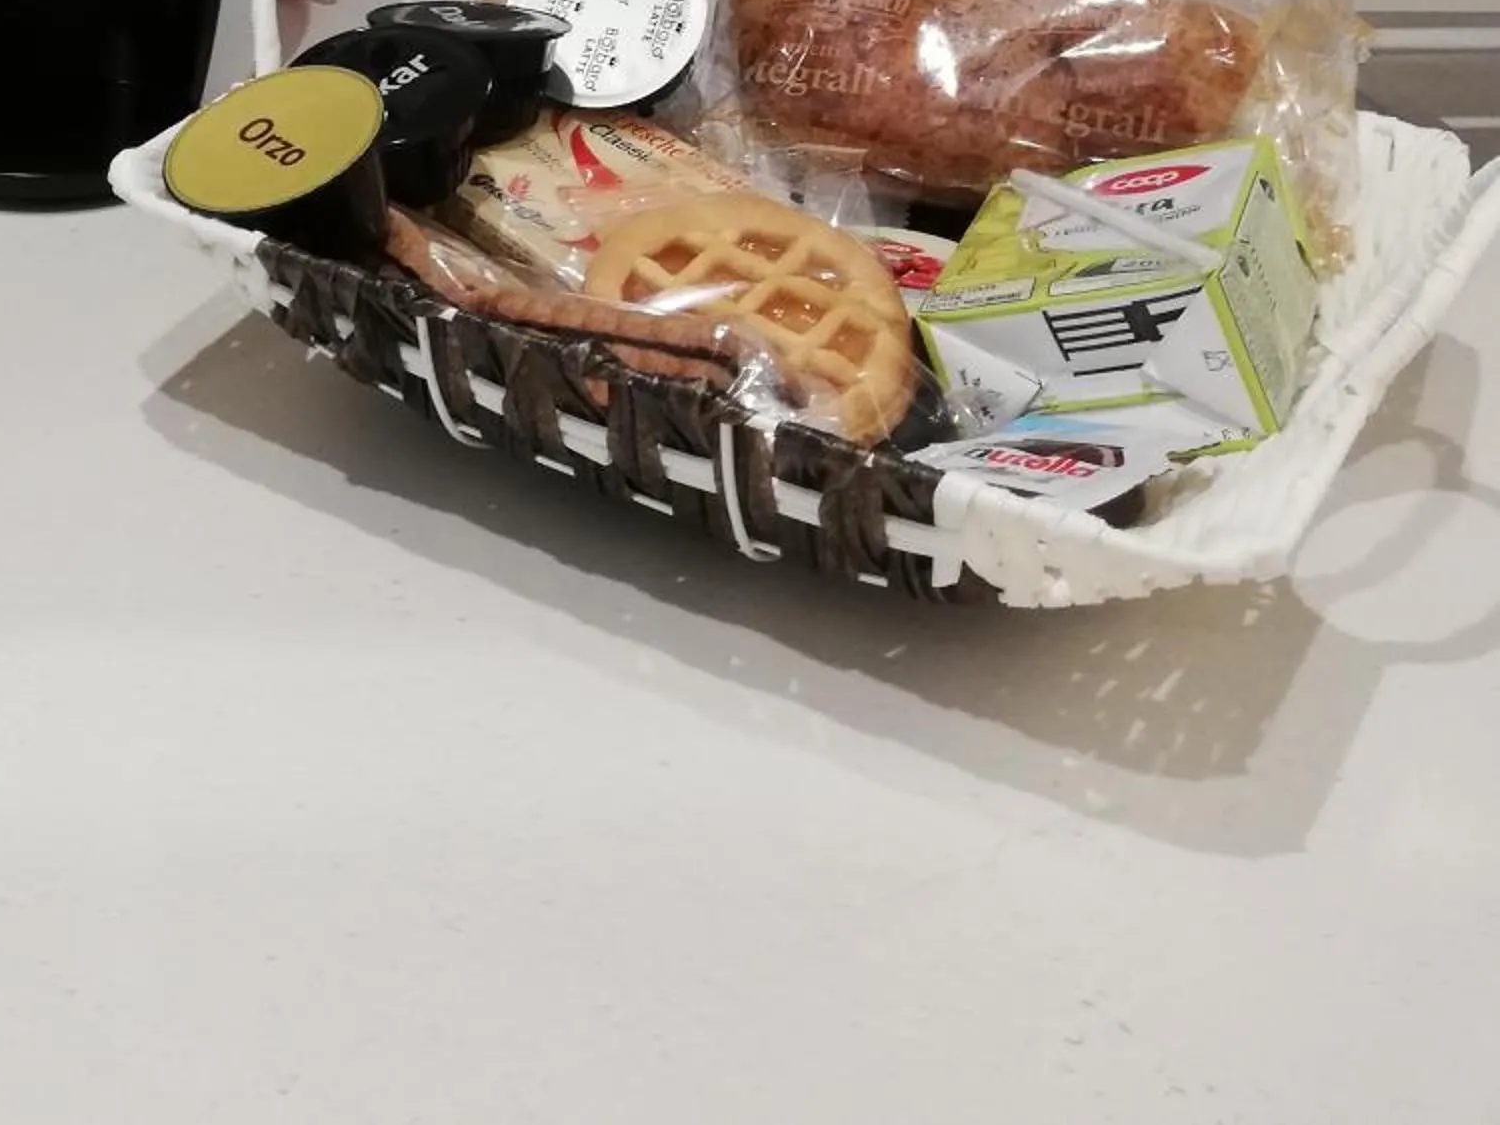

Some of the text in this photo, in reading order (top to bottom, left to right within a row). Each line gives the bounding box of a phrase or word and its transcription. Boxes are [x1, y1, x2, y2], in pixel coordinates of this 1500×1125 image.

[643, 5, 663, 42] LATTE
[379, 54, 430, 96] kar
[576, 38, 597, 75] LATTE
[238, 117, 306, 167] Orzo
[1107, 170, 1180, 191] coop
[964, 446, 1101, 478] nutella
